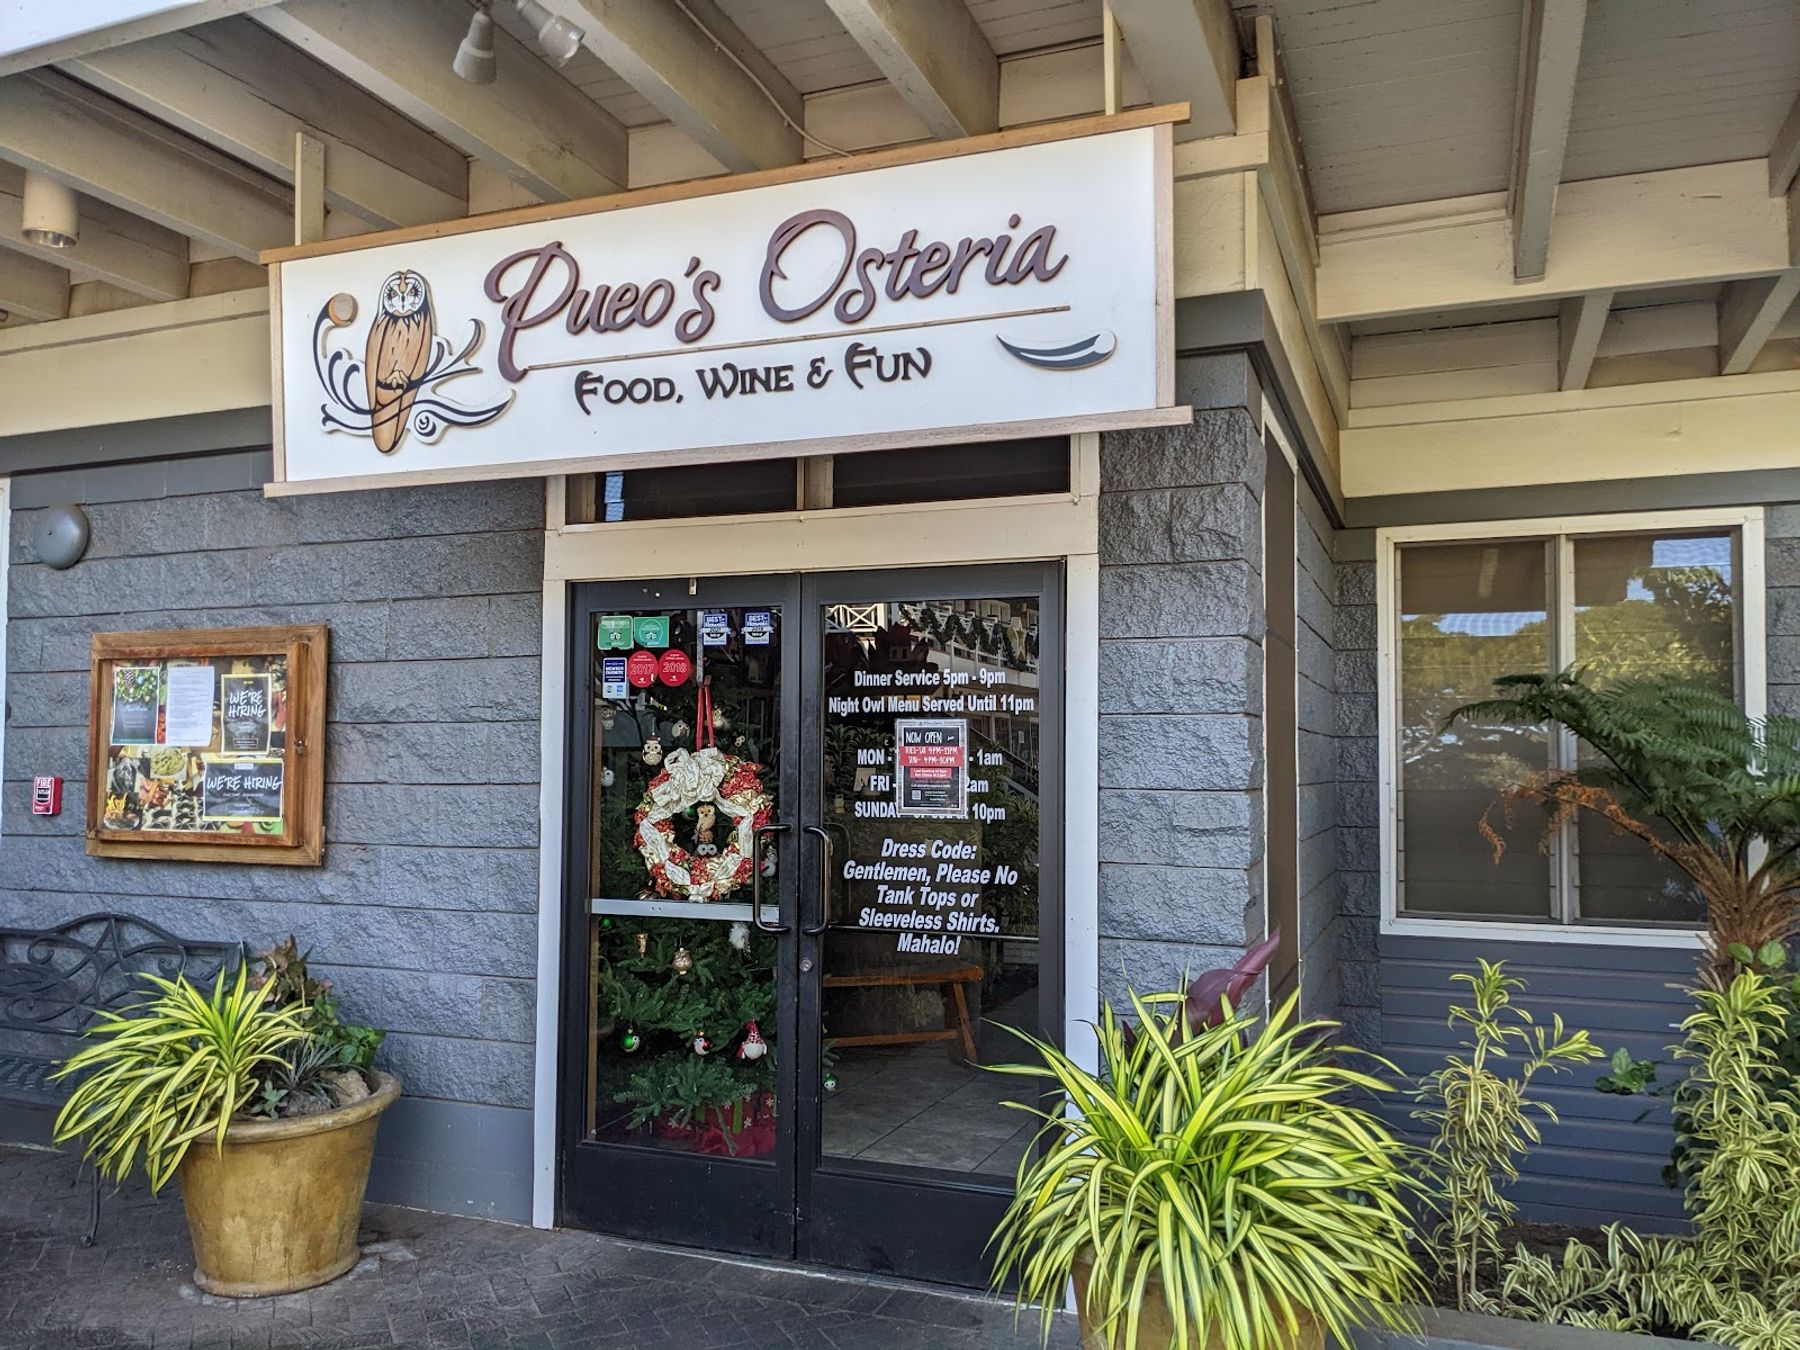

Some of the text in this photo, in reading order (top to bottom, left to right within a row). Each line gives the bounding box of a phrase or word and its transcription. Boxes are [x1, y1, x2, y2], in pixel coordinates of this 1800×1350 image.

[483, 208, 1069, 383] Pueo's Osteria
[806, 356, 834, 389] &
[630, 663, 654, 675] 2017
[662, 662, 687, 673] 2018
[854, 670, 892, 686] Dinner
[895, 669, 940, 686] Service
[943, 669, 969, 688] 5pm
[979, 668, 1006, 688] 9pm
[229, 689, 264, 706] WE'RE
[828, 694, 1034, 716] Night Owl Menu Served Until 11pm
[228, 703, 266, 718] HIRING
[905, 732, 921, 743] NOW
[925, 731, 942, 743] OPEN
[857, 749, 884, 765] MON
[977, 750, 1003, 766] 1am
[206, 775, 283, 790] WE'RE HIRING
[870, 776, 889, 791] FRI
[972, 804, 1006, 825] 10pm
[881, 838, 977, 860] Dress Code:
[843, 860, 1018, 885] Gentlemen, Please No
[877, 885, 979, 910] Tank Tops or
[859, 907, 1000, 933] Sleeveless Shirts.
[896, 933, 962, 955] Mahalo!
